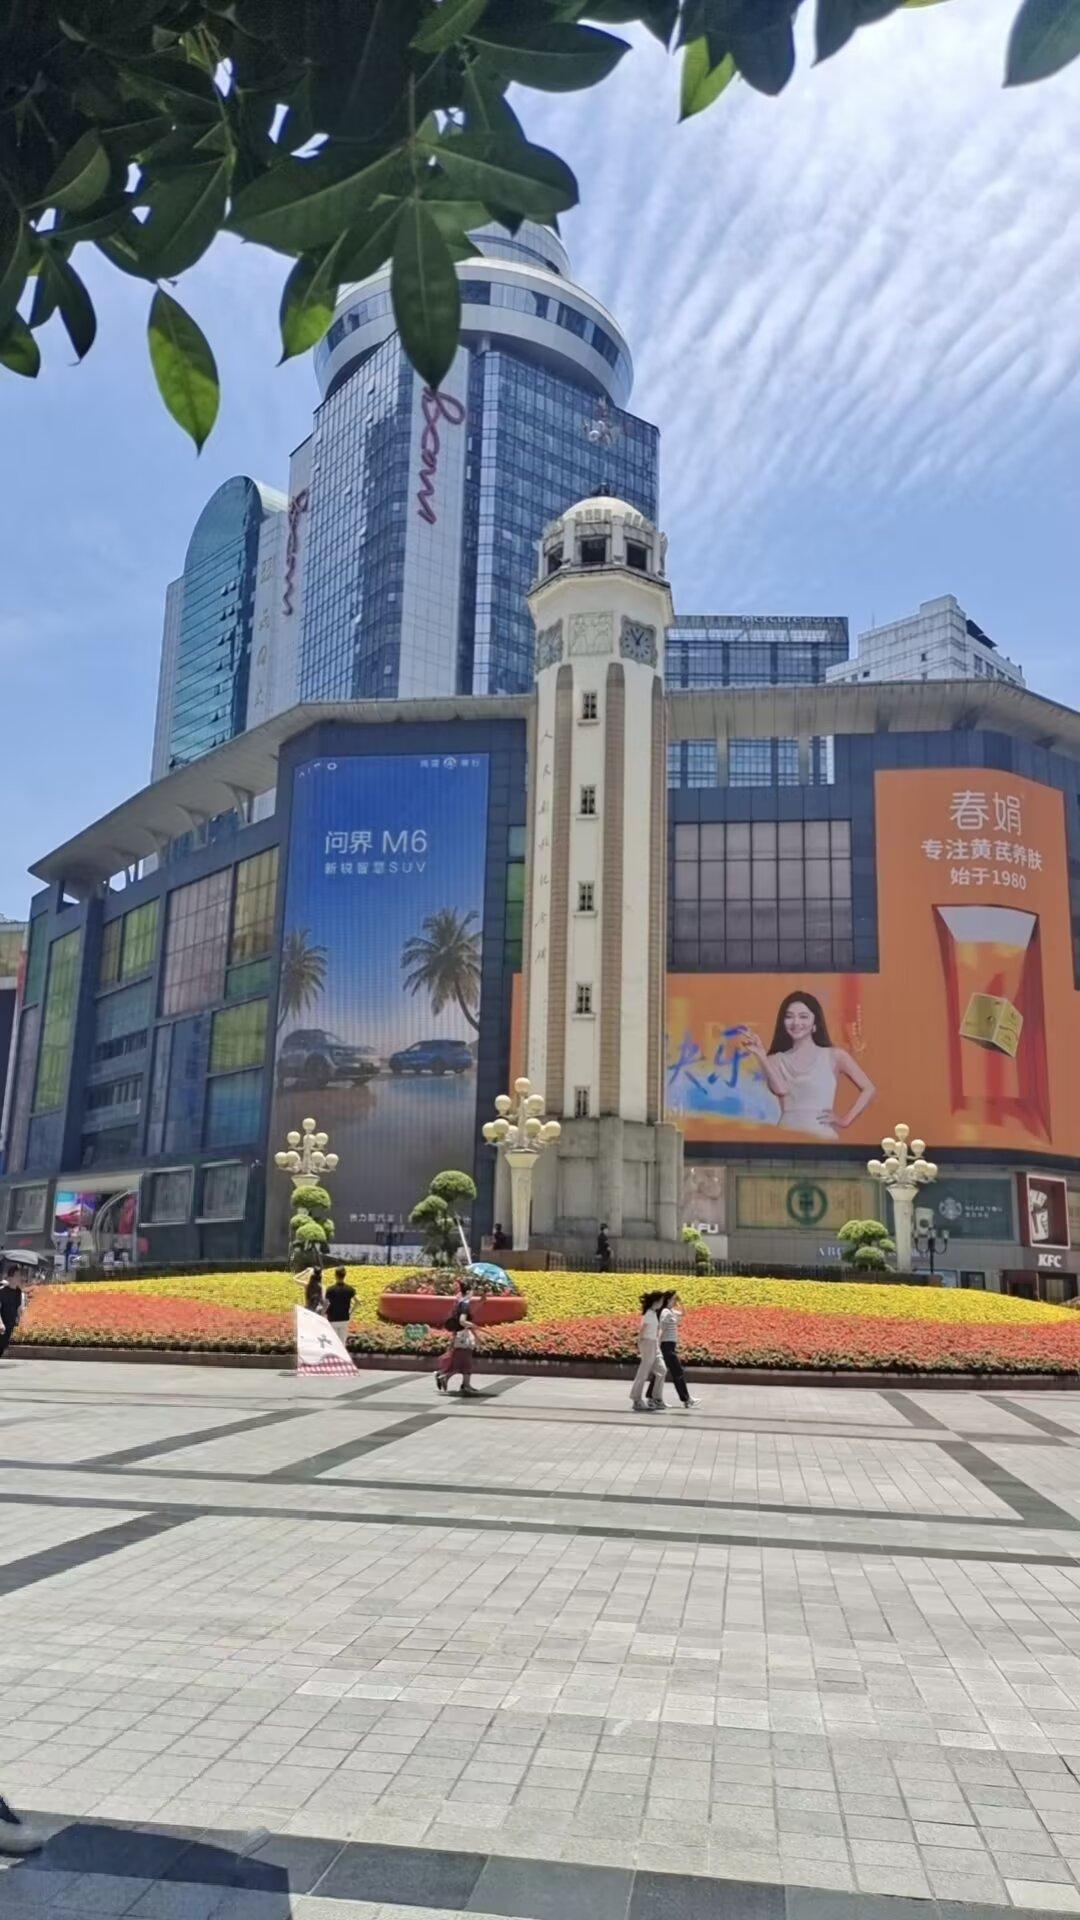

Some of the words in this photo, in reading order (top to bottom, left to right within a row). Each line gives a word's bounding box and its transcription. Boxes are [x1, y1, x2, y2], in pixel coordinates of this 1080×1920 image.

[949, 790, 1022, 836] 春娟
[325, 830, 373, 854] 问界
[382, 829, 428, 854] M6
[950, 867, 1027, 890] 始于1980
[1038, 1253, 1062, 1268] KFC
